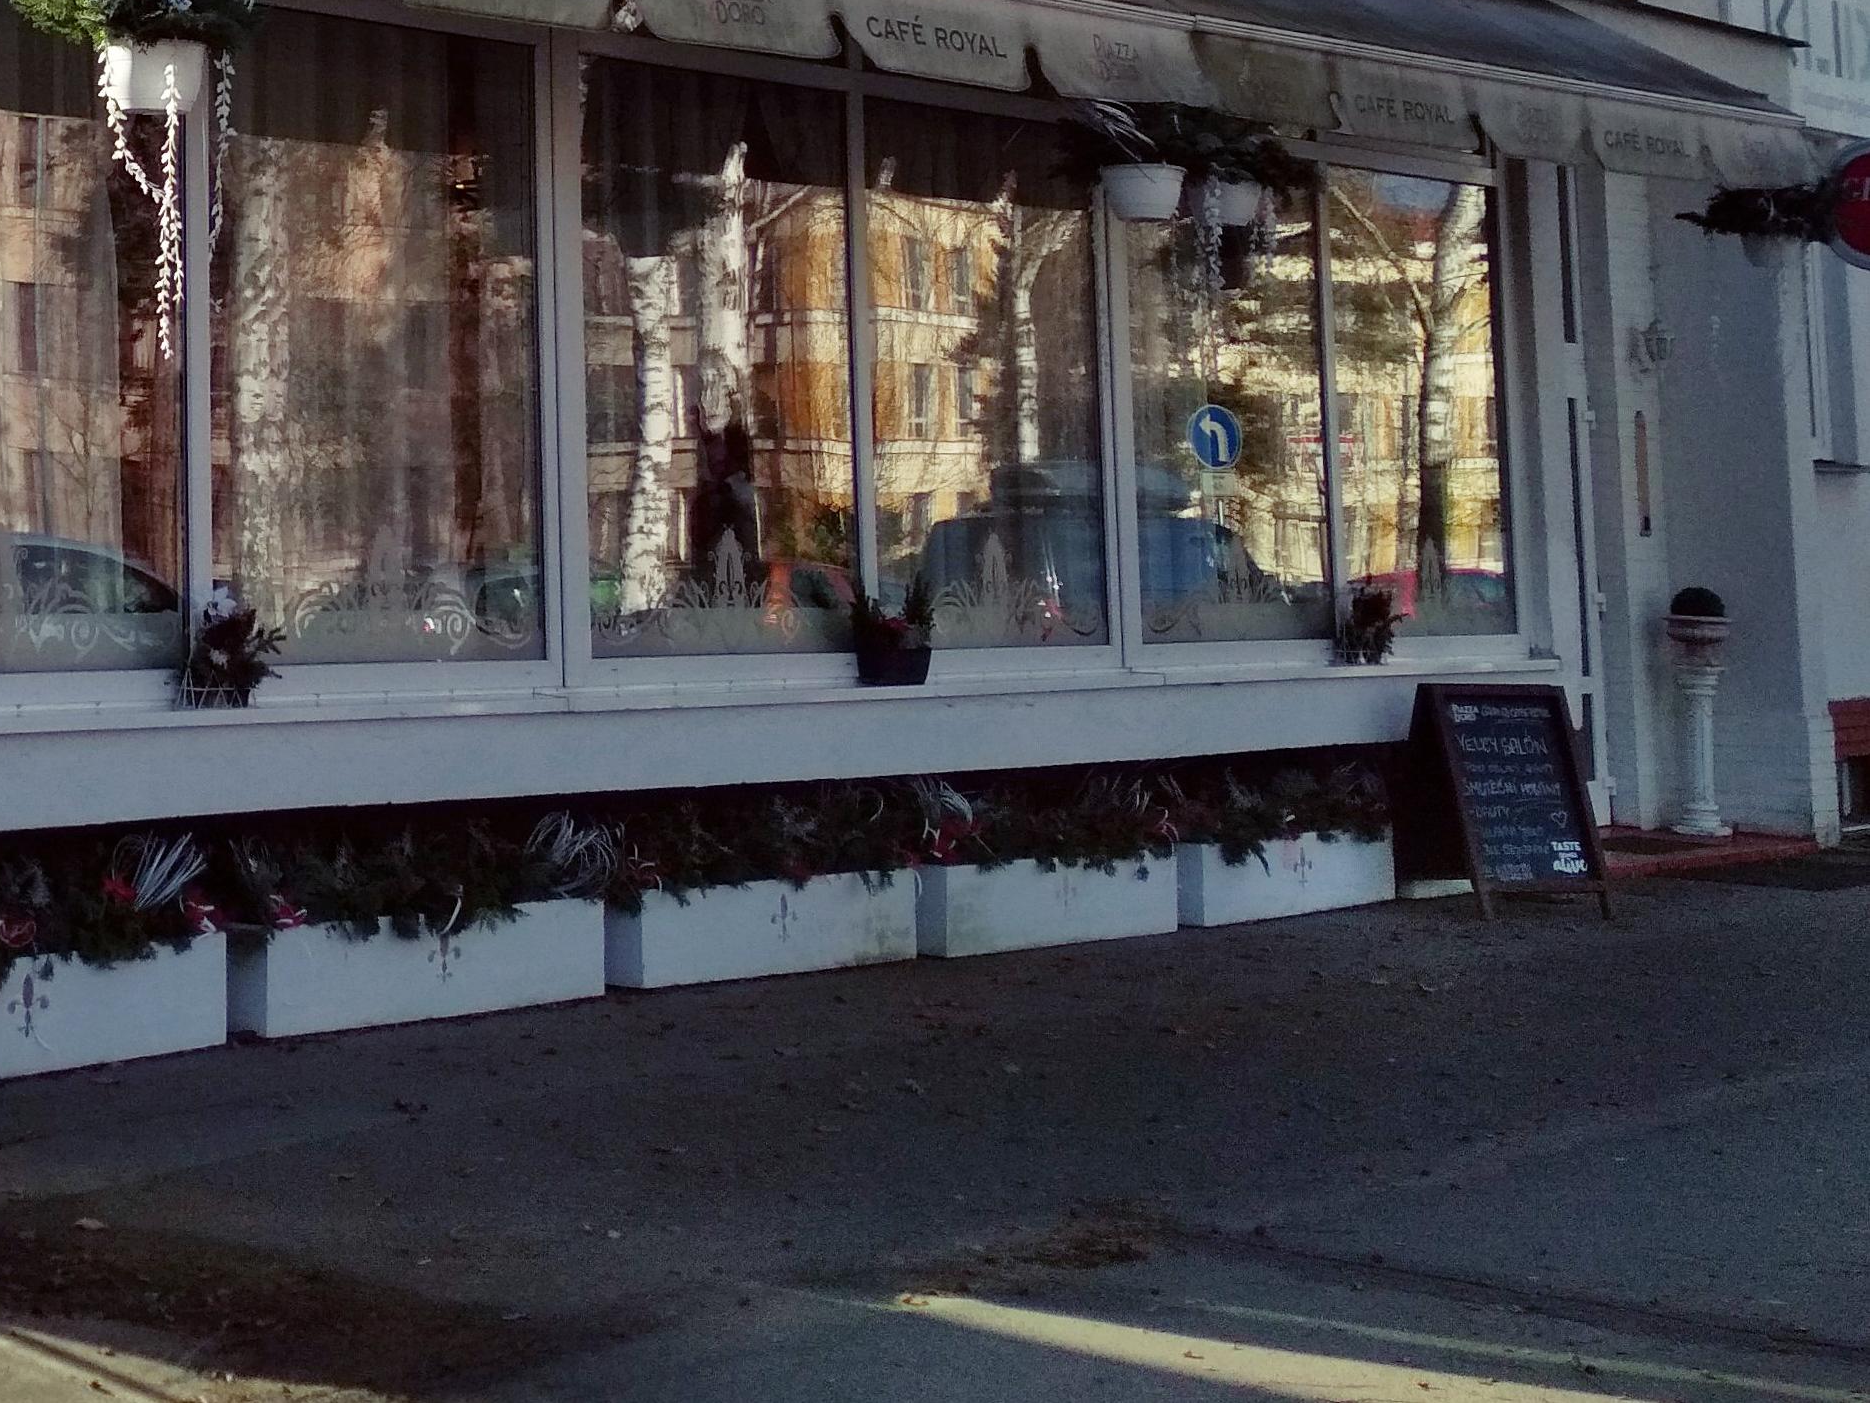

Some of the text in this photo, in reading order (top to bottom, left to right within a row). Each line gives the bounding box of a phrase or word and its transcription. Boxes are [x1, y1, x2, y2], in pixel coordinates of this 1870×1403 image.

[866, 14, 1008, 59] CAFÉ ROYAL
[1354, 91, 1455, 125] CAFÉ ROYAL
[1604, 128, 1691, 158] CAFÉ ROYAL
[1550, 841, 1581, 851] TASTE
